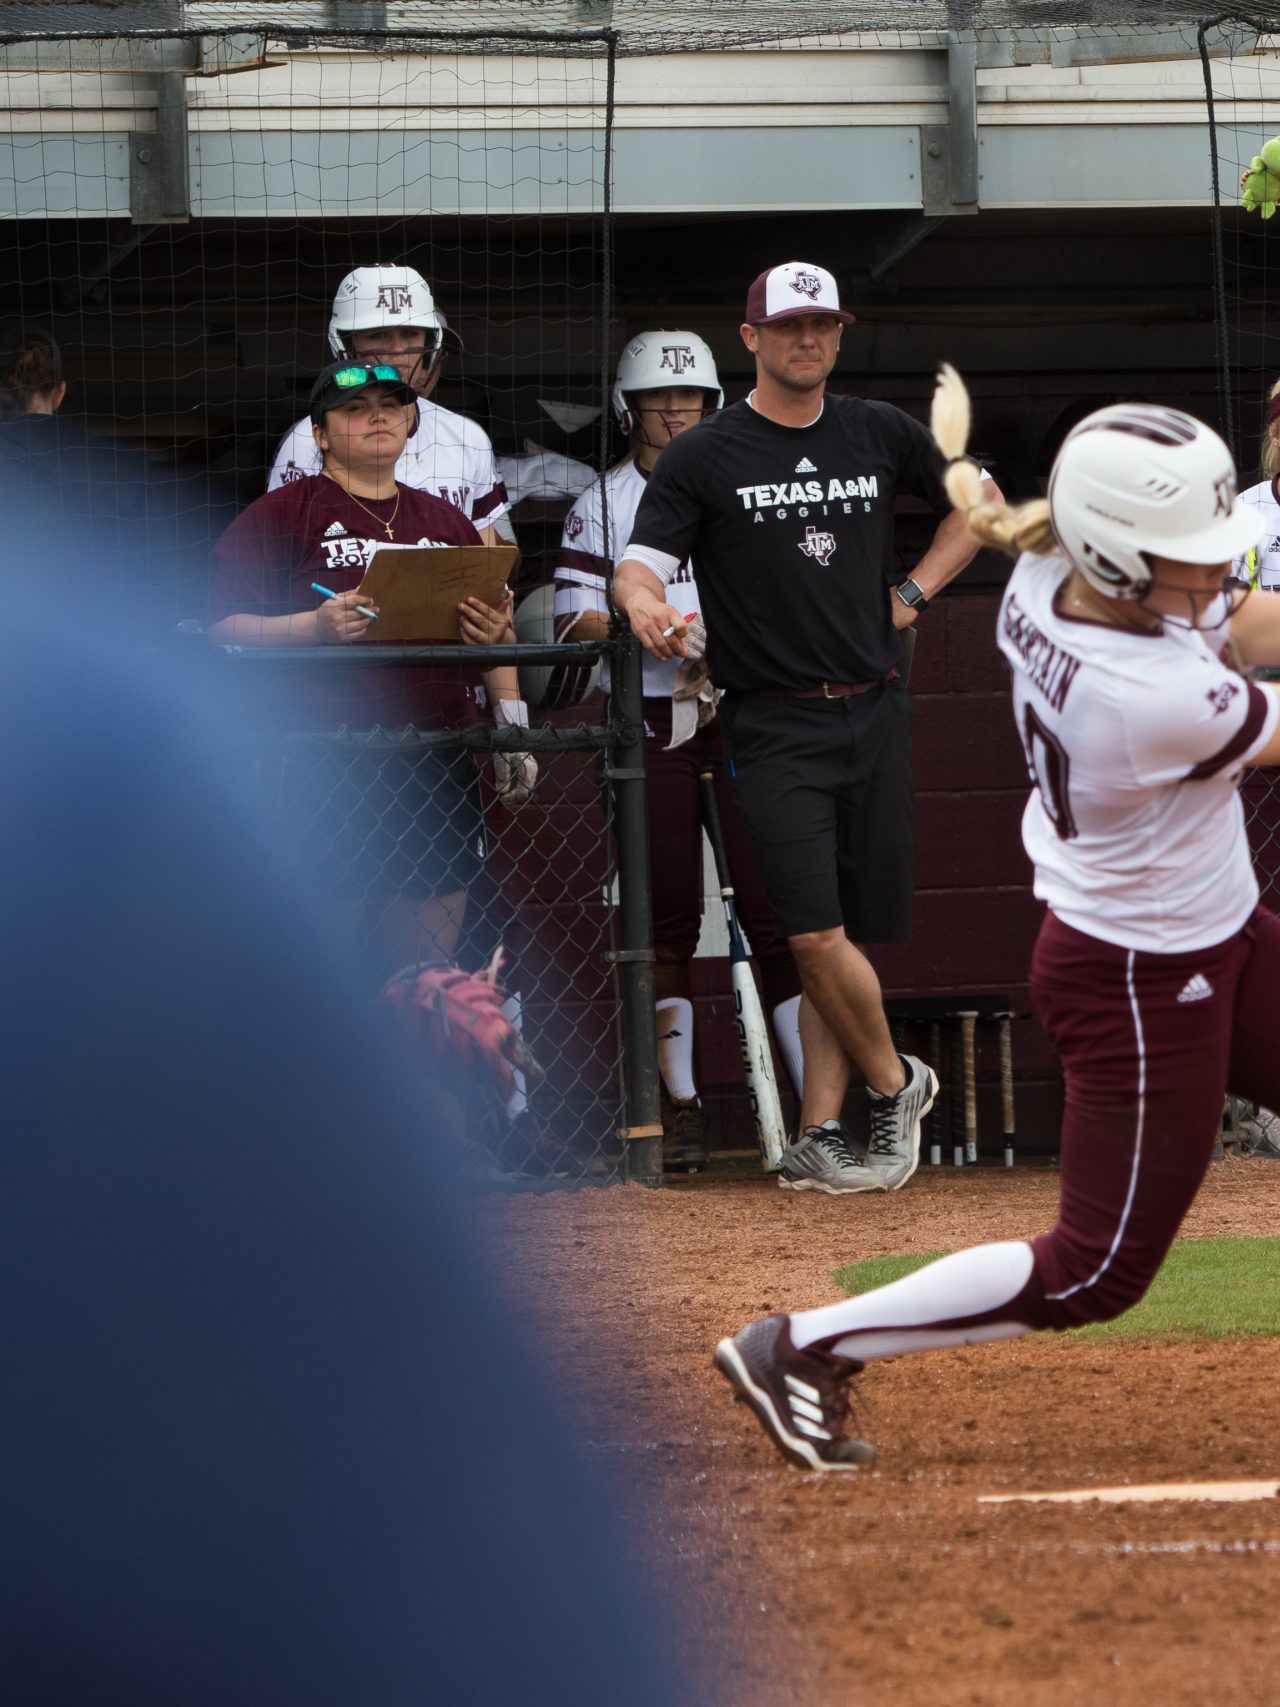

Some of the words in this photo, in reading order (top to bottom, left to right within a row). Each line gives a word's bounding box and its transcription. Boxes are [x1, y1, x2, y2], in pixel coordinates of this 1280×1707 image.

[736, 480, 824, 510] TEXAS
[827, 476, 879, 501] A&M
[754, 501, 872, 524] AGGIES
